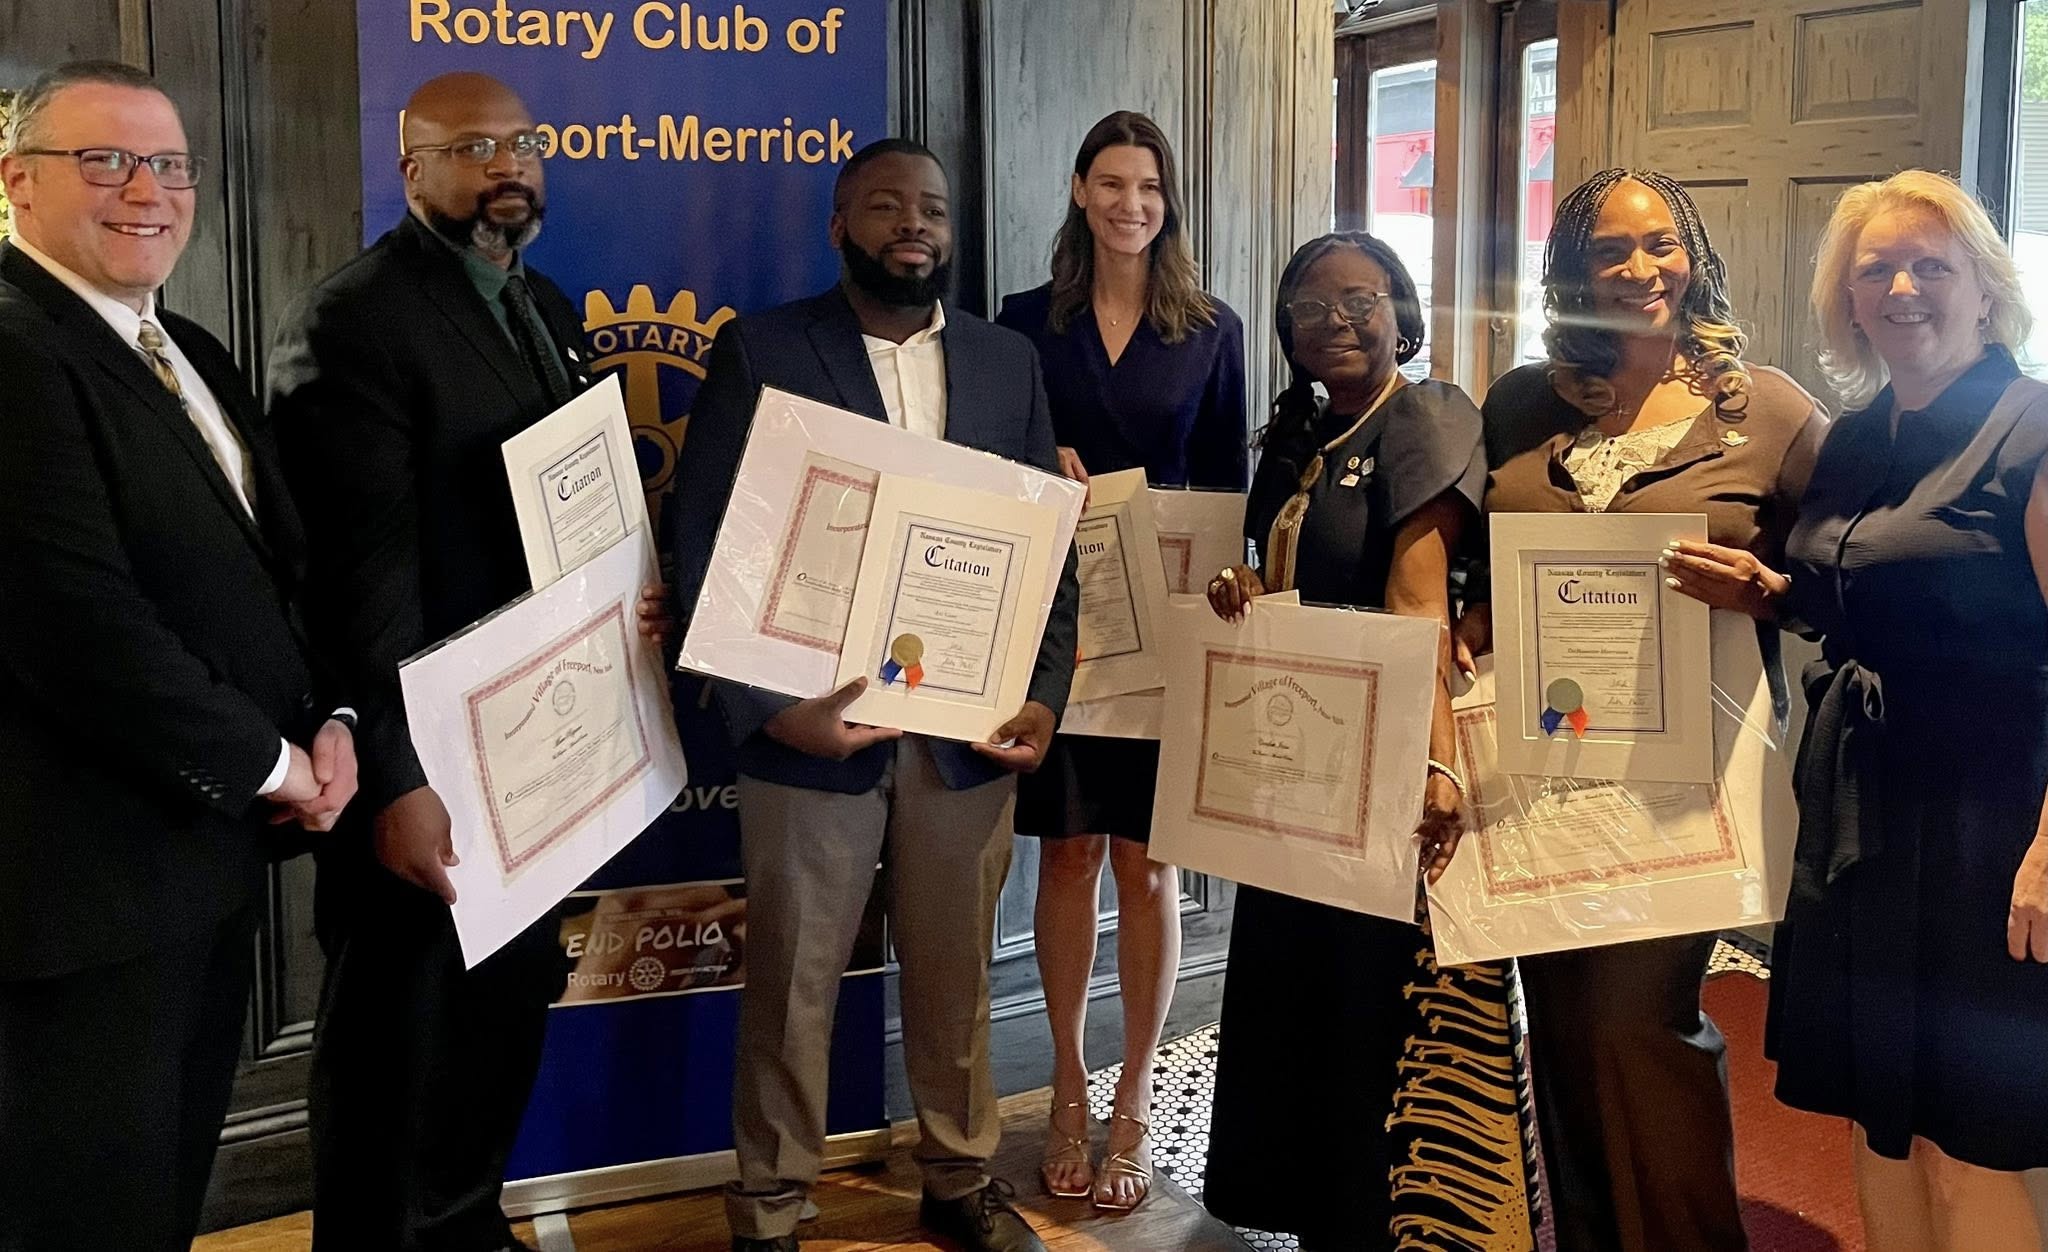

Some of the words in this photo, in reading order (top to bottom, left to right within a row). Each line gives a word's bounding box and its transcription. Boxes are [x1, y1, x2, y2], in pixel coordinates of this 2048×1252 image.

[410, 0, 614, 59] Rotary
[633, 2, 768, 51] Club
[786, 8, 845, 54] of
[399, 110, 854, 164] port-Merrick
[586, 324, 713, 361] OTARY
[558, 467, 601, 501] Citation
[924, 545, 990, 577] Citation
[1079, 542, 1105, 555] tion
[1558, 579, 1638, 604] Citation
[635, 921, 724, 951] POLIO
[567, 972, 626, 988] Rotary
